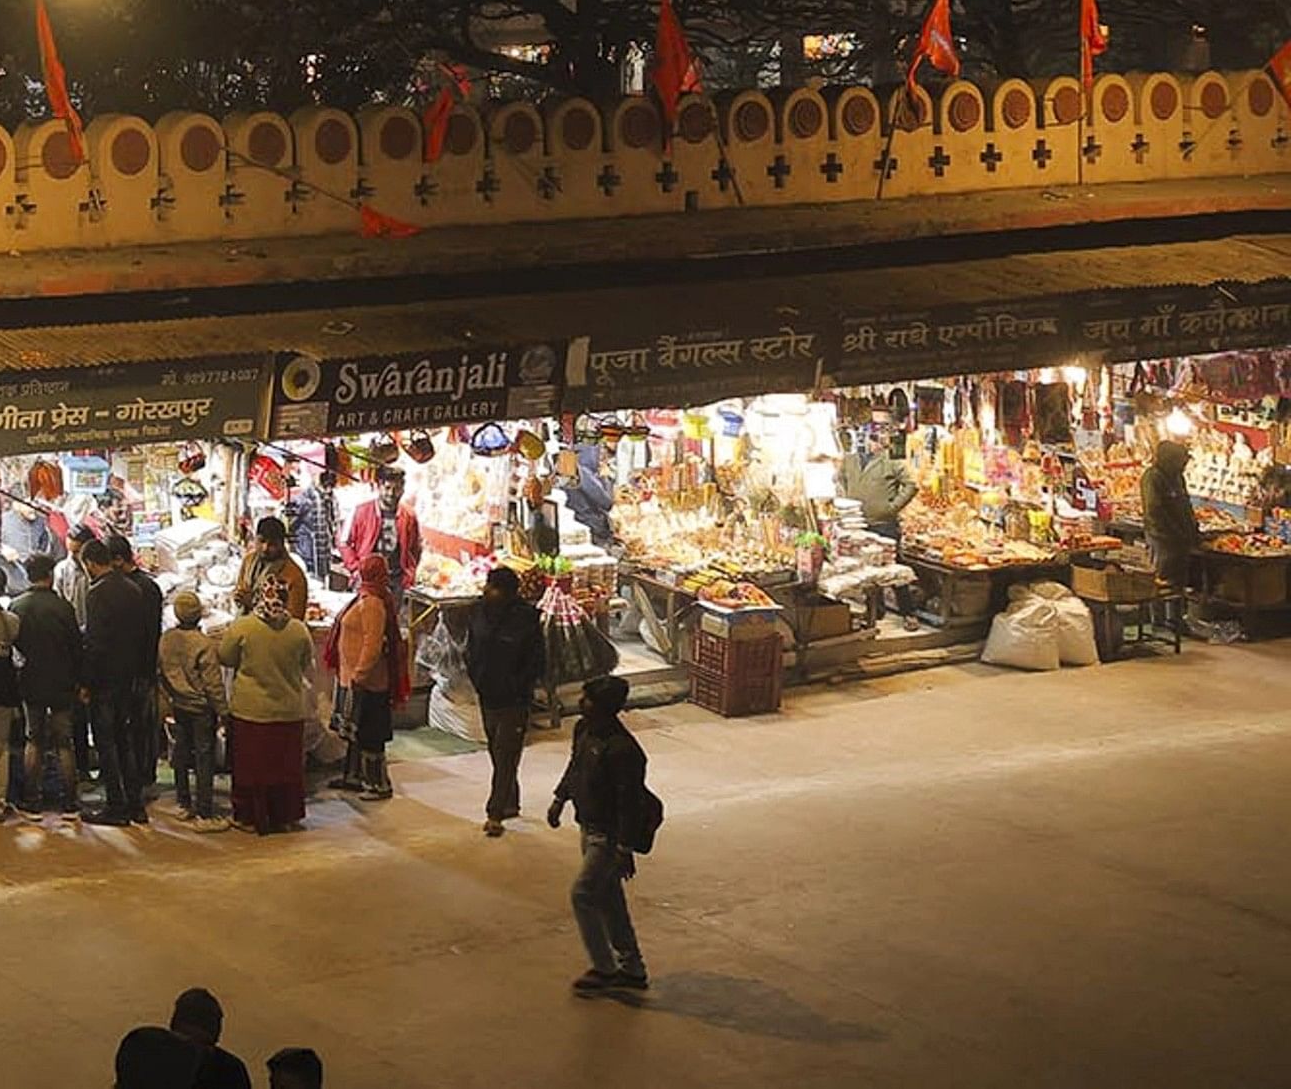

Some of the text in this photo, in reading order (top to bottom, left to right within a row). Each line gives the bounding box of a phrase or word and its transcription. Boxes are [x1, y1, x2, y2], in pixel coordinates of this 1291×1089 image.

[841, 325, 877, 353] श्री
[884, 321, 931, 349] राधे
[590, 348, 650, 387] पूजा
[750, 327, 815, 361] स्टोर
[335, 352, 508, 404] Swaranjali
[51, 402, 90, 429] प्रेस
[116, 398, 213, 426] गोरखपुर
[336, 412, 364, 428] ART
[369, 411, 378, 425] &
[383, 408, 429, 424] CRAFT
[434, 401, 499, 422] GALLERY
